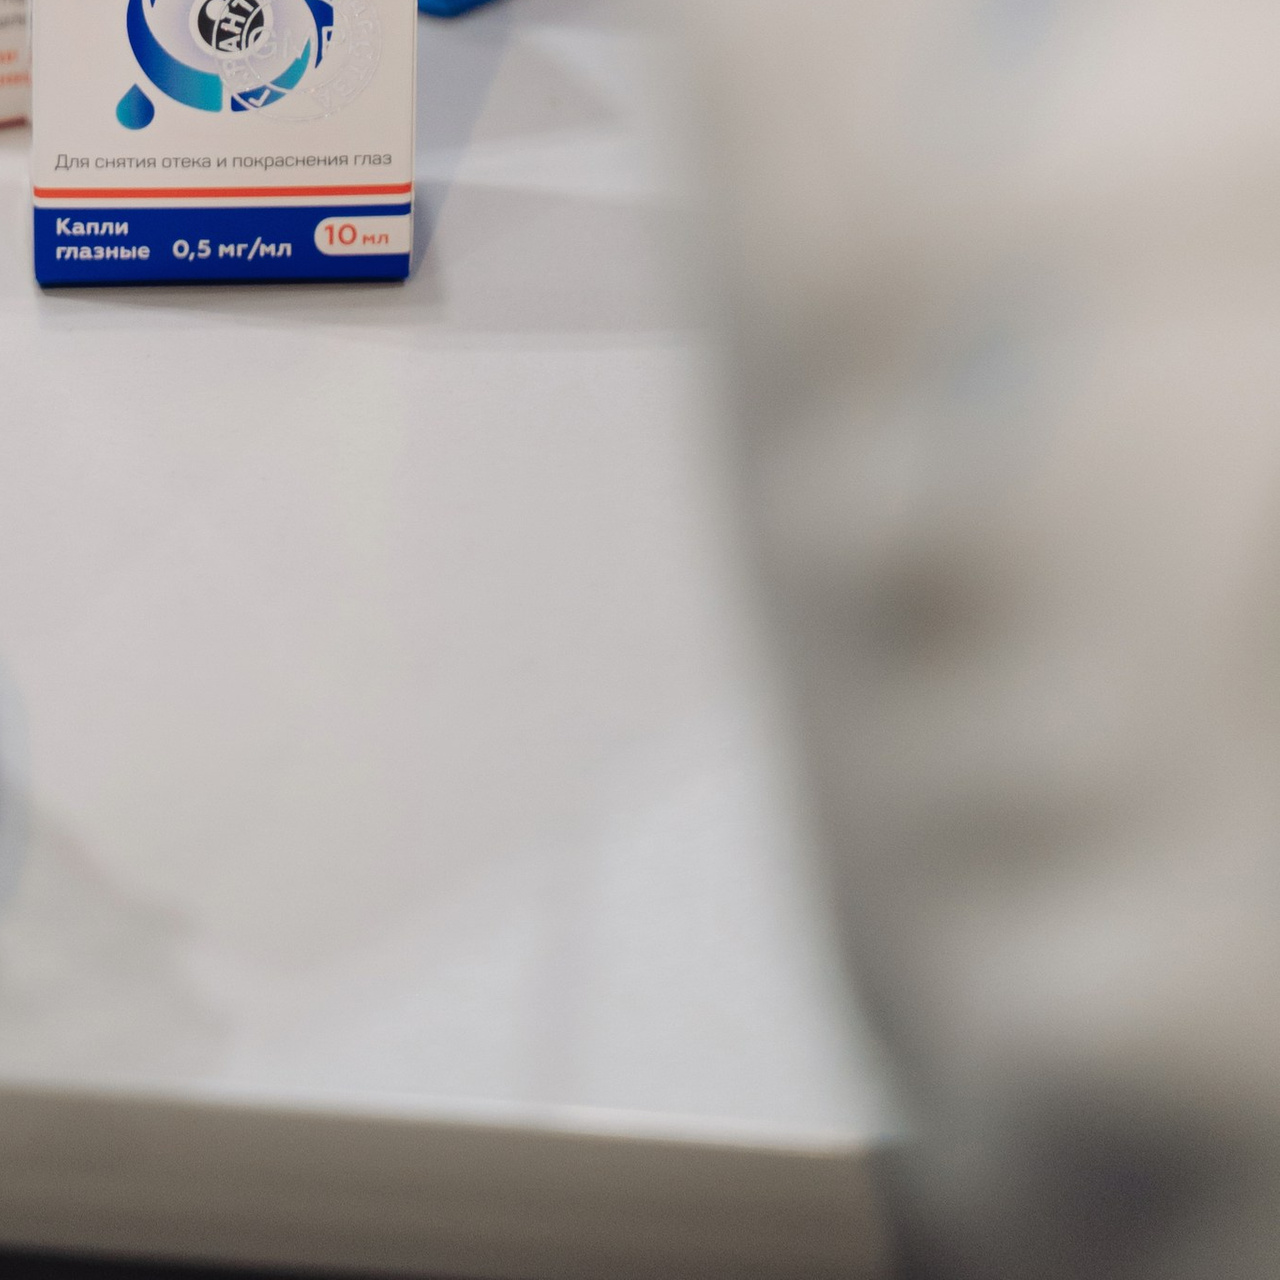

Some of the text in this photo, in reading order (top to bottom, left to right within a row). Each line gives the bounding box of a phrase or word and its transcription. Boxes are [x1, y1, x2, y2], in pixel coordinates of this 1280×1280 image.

[54, 153, 393, 171] Для снятия отека и покраснения глаз
[55, 217, 129, 237] Капли
[324, 223, 390, 246] 10 мл
[55, 236, 293, 262] глазные 0,5 мг/мл
